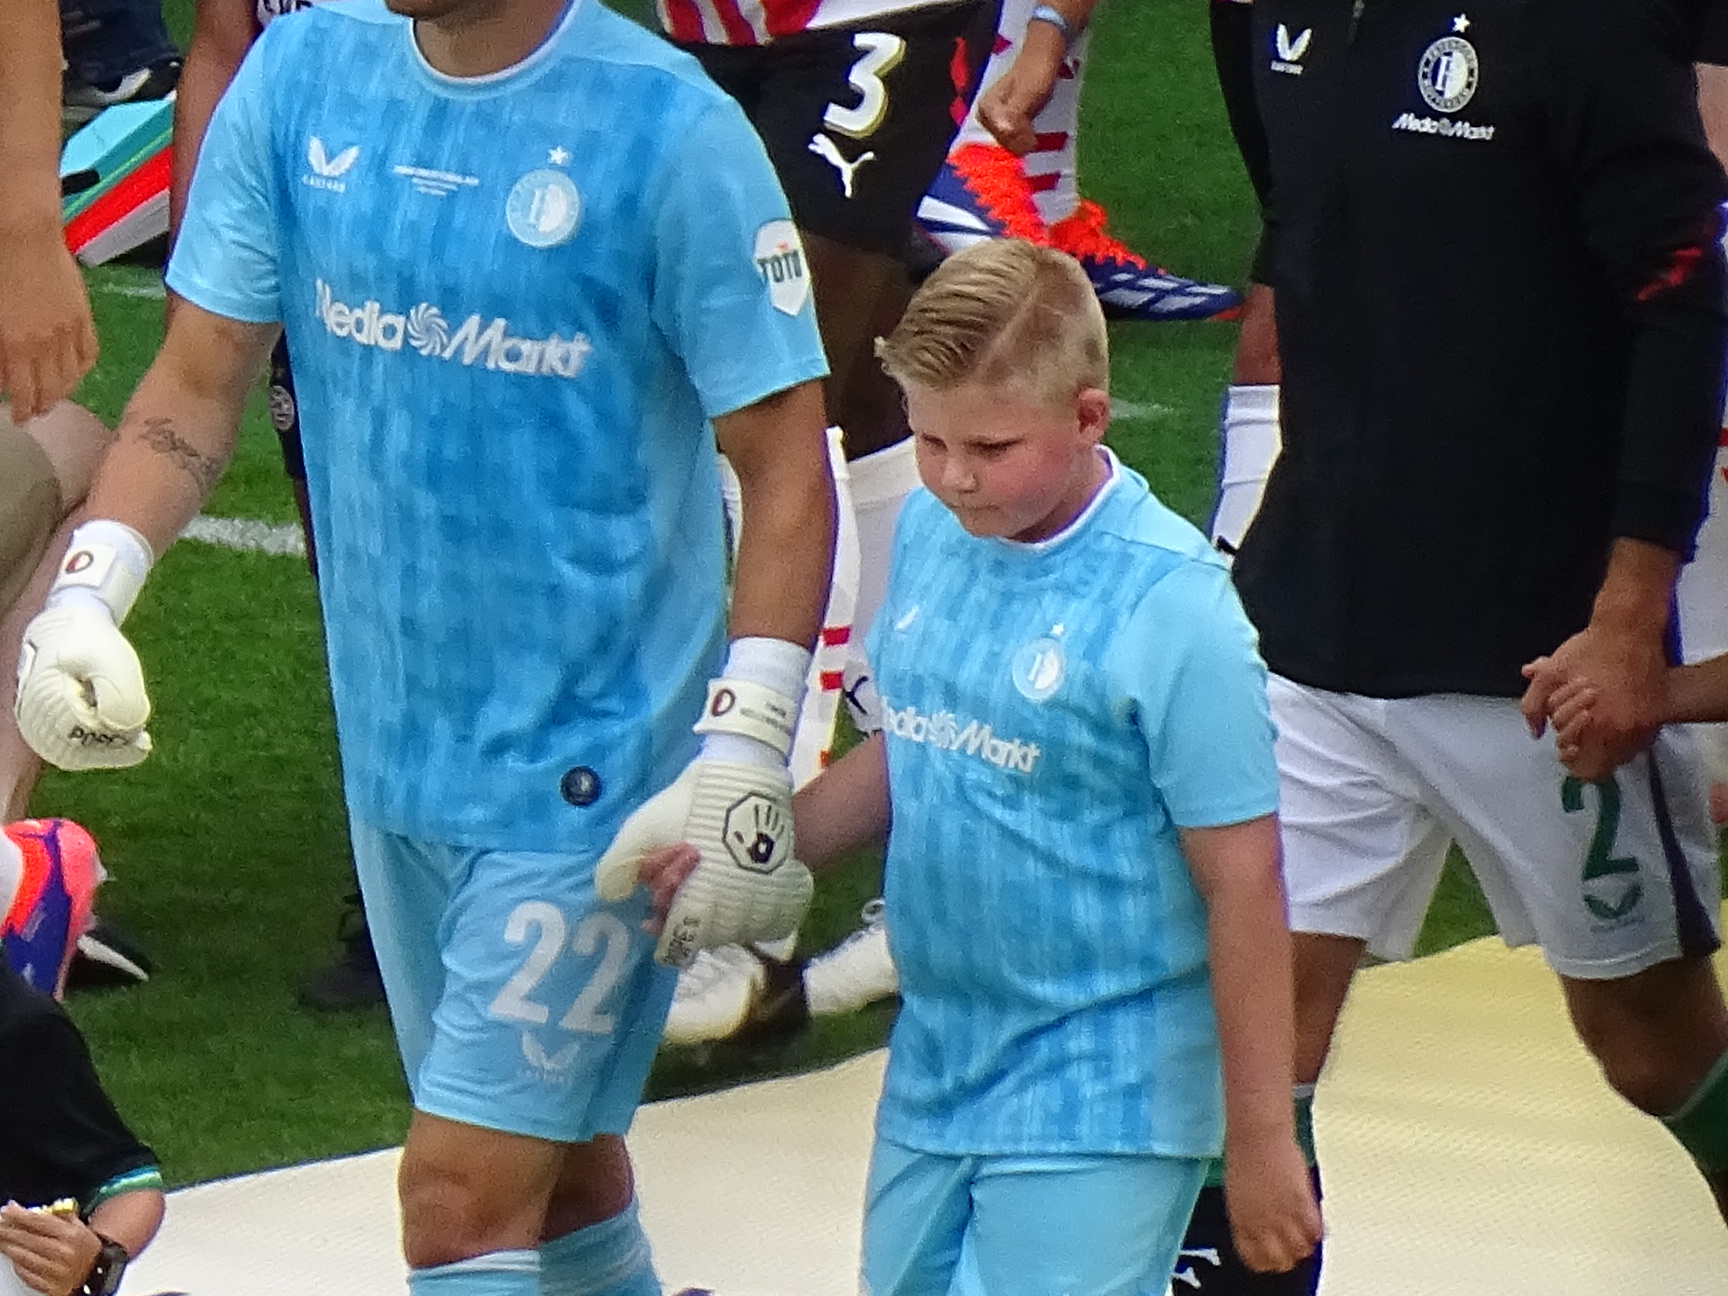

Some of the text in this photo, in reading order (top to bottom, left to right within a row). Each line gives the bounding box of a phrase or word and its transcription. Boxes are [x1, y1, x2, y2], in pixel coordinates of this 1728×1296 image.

[820, 31, 903, 135] 3
[1561, 775, 1640, 882] 2
[492, 899, 631, 1036] 22
